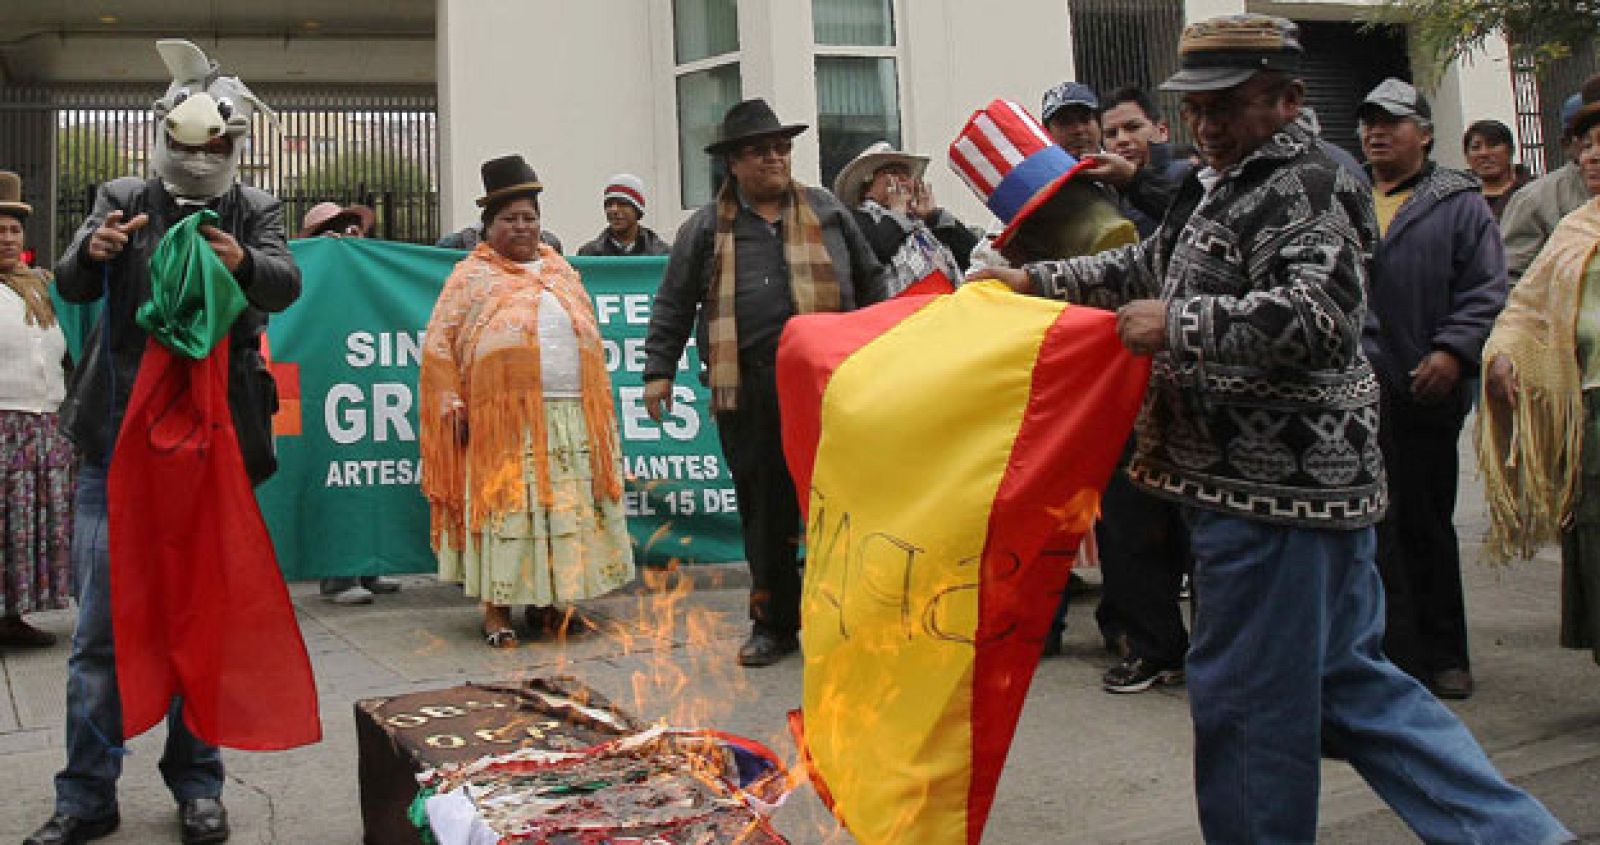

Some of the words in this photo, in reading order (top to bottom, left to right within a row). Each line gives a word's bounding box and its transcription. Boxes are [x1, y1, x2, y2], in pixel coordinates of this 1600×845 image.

[595, 294, 655, 324] FE
[664, 490, 695, 515] 15
[703, 488, 738, 513] DE
